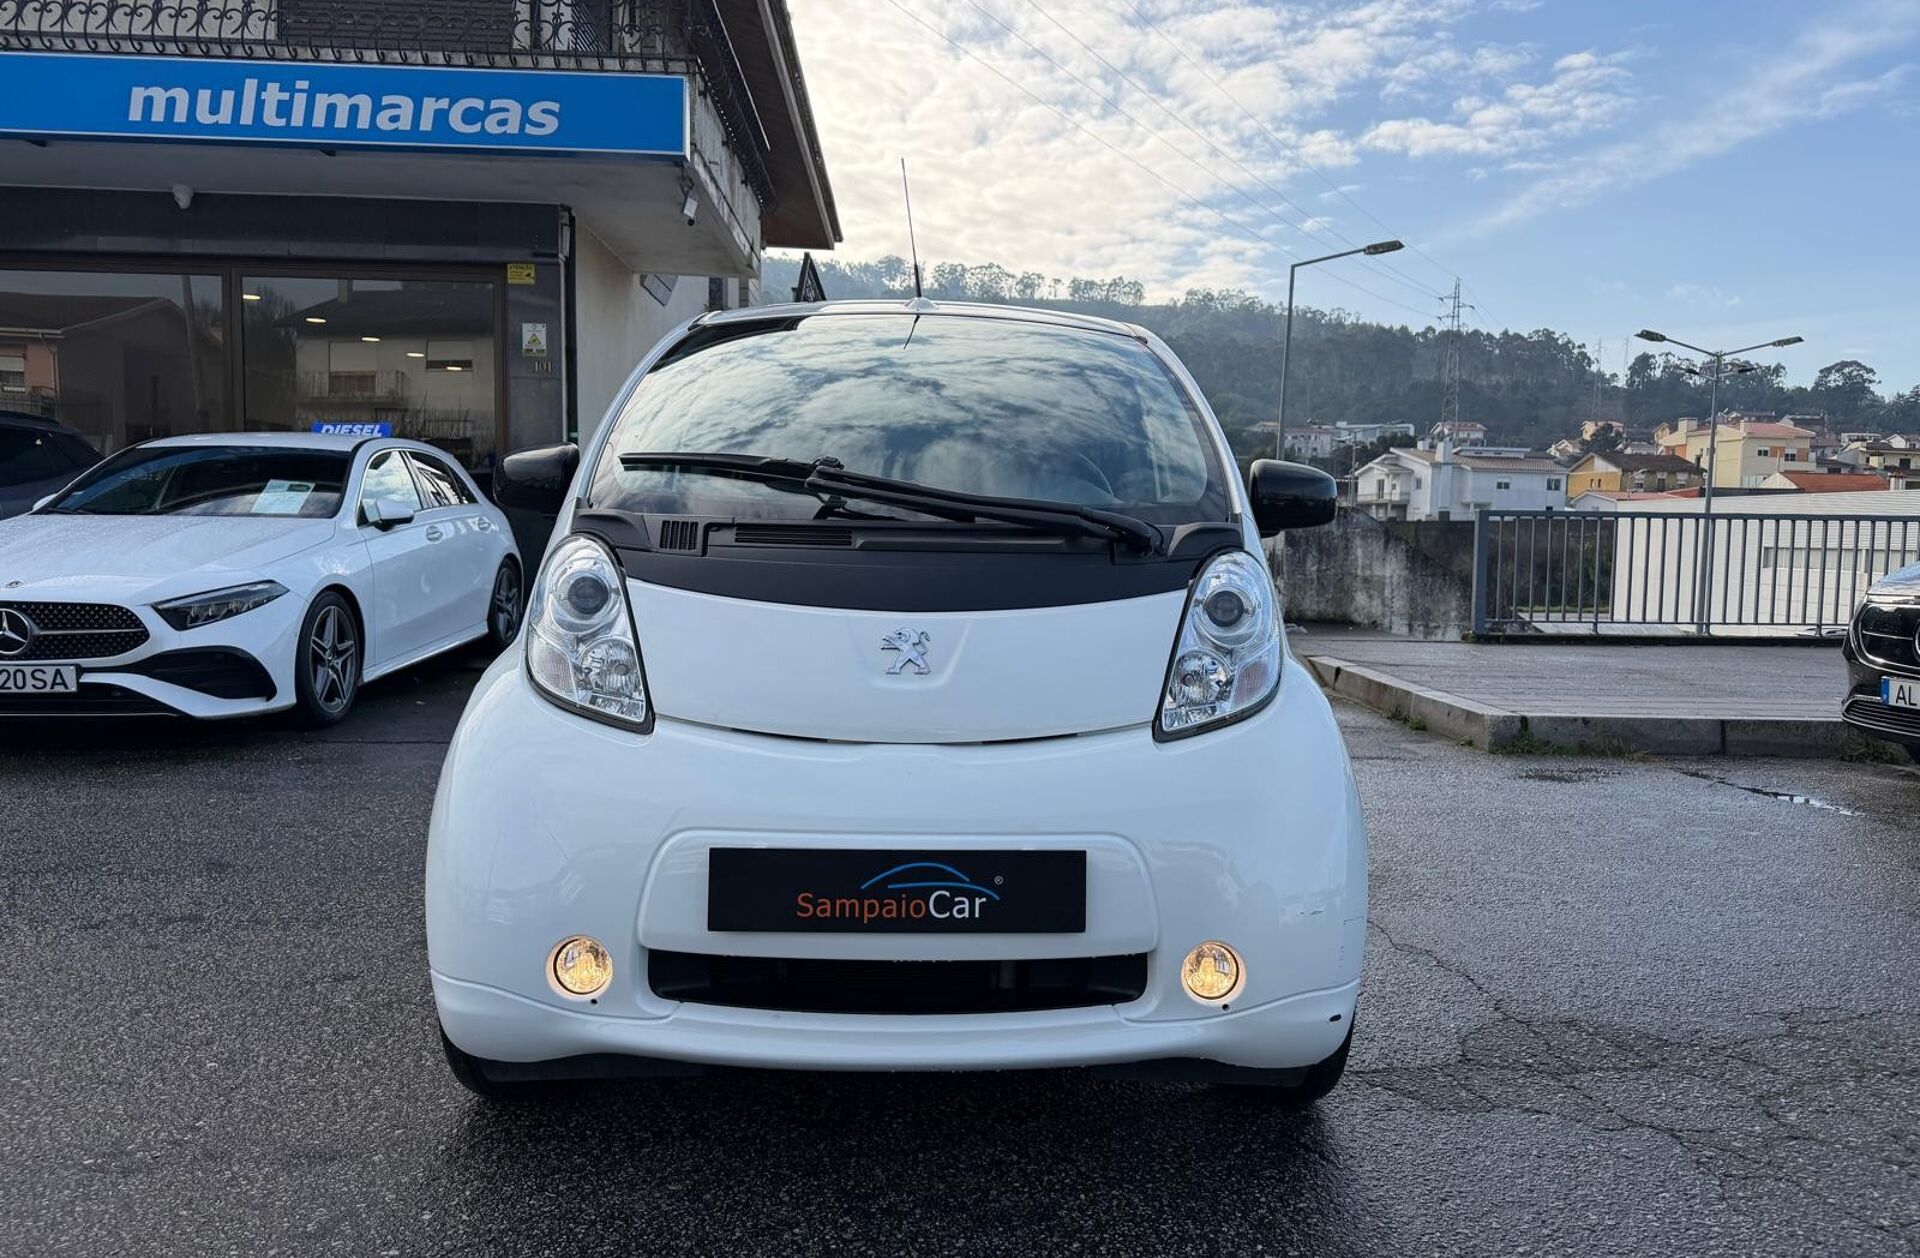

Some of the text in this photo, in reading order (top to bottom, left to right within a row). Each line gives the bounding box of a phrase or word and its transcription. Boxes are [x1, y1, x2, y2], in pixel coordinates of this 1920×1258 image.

[128, 78, 561, 135] multimarcas
[321, 424, 382, 437] DIESEL
[1896, 684, 1917, 706] AL
[796, 890, 987, 924] SampaioCar
